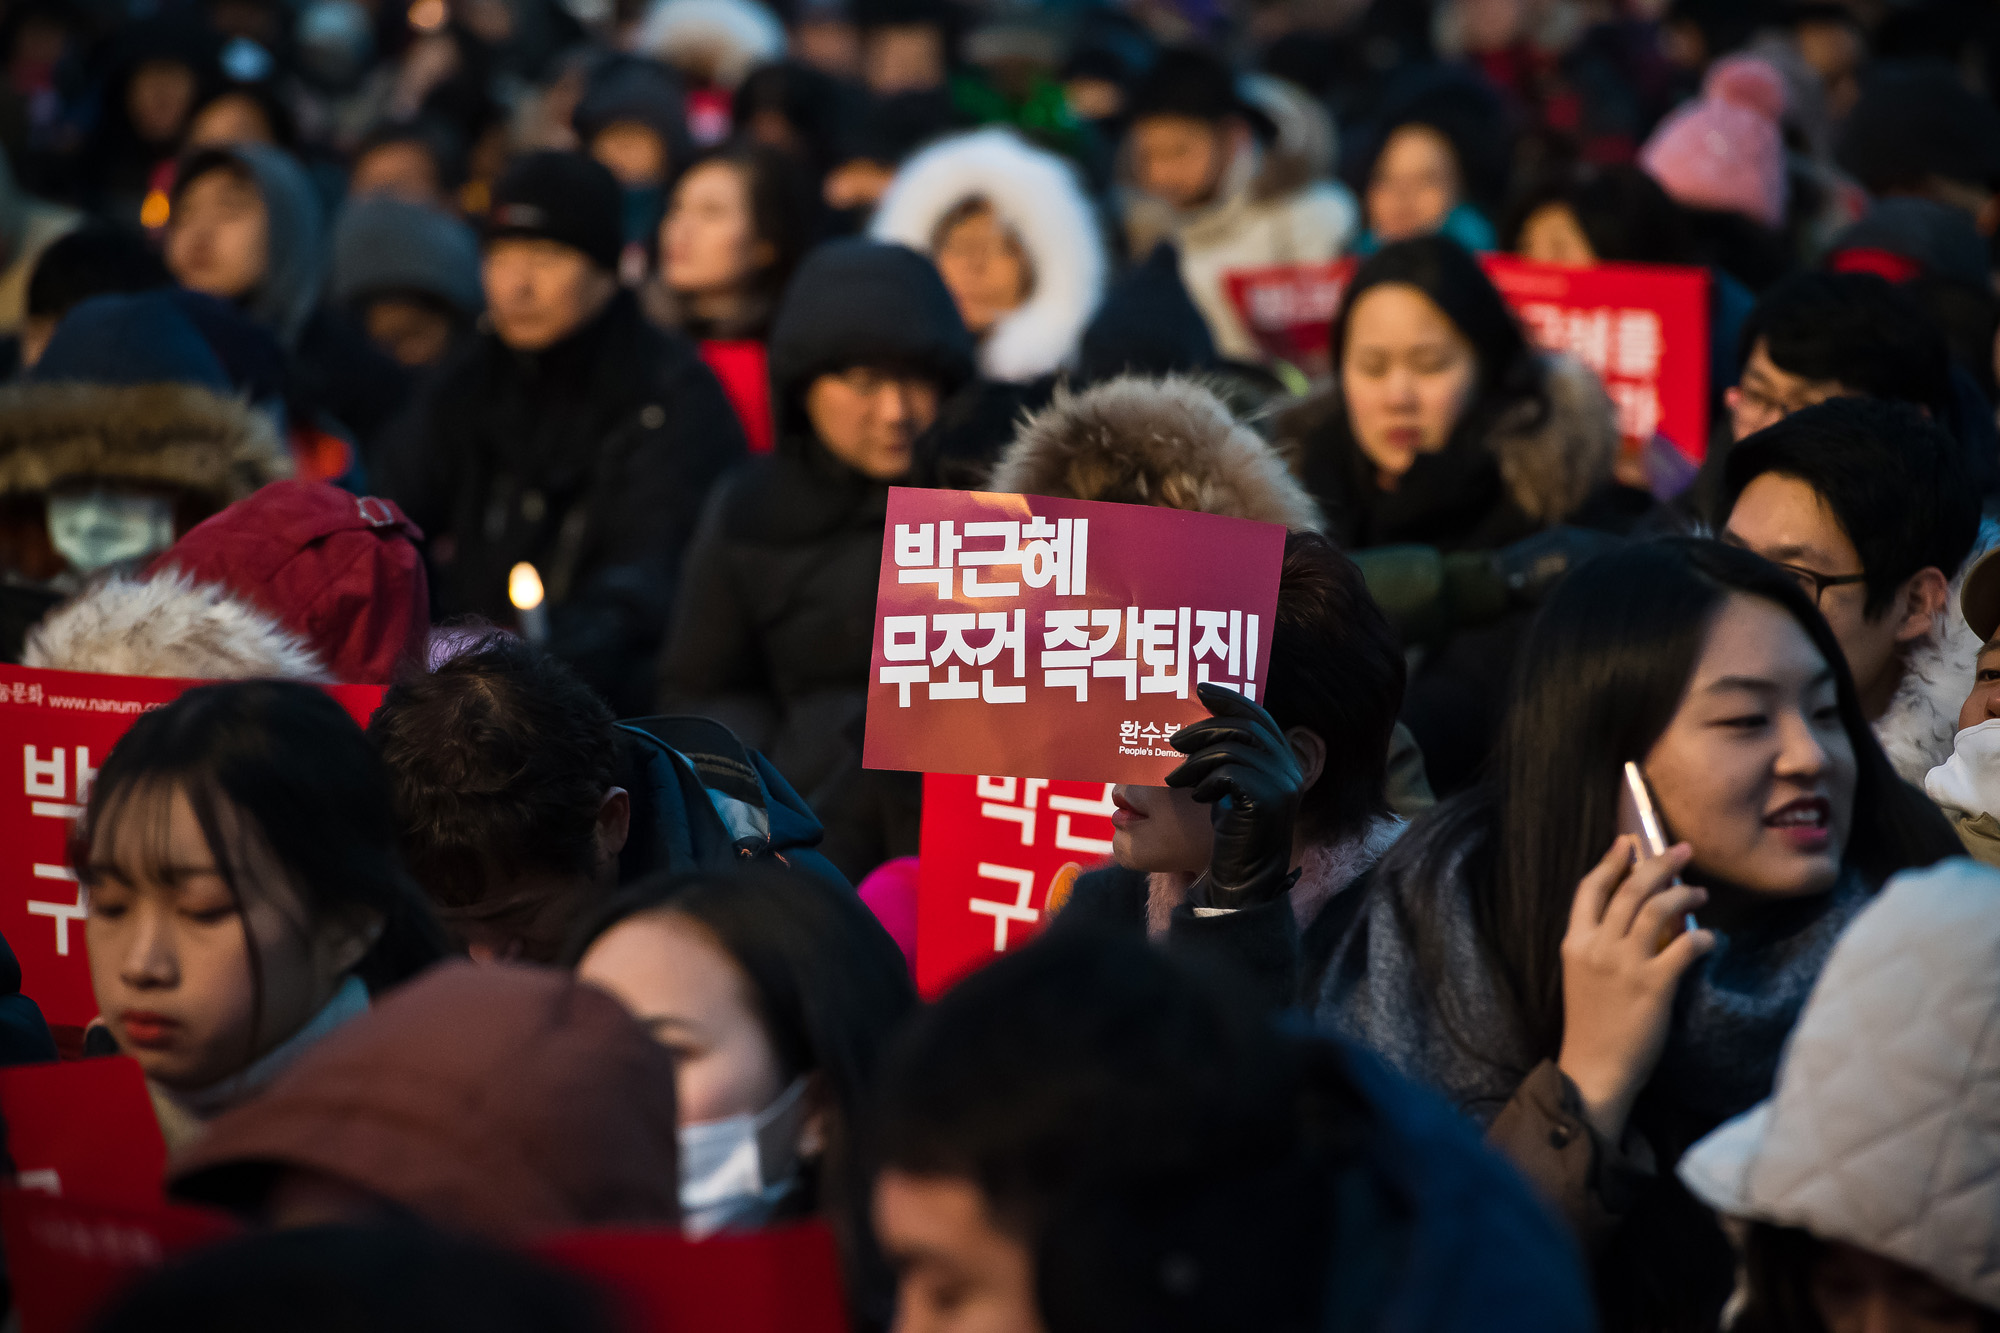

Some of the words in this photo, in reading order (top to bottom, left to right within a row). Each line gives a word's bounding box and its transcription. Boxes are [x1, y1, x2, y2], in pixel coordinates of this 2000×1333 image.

[894, 516, 1089, 600] 박근혜
[879, 609, 1027, 708] 무조건
[1041, 606, 1260, 702] 즉각퇴진!
[49, 695, 169, 714] www.nanum.co
[1119, 720, 1188, 746] 환수복
[24, 744, 98, 840] 박
[1119, 745, 1153, 757] People's
[1154, 747, 1189, 758] Democra
[976, 774, 1119, 855] 박근
[28, 862, 90, 956] 구
[969, 862, 1040, 952] 구
